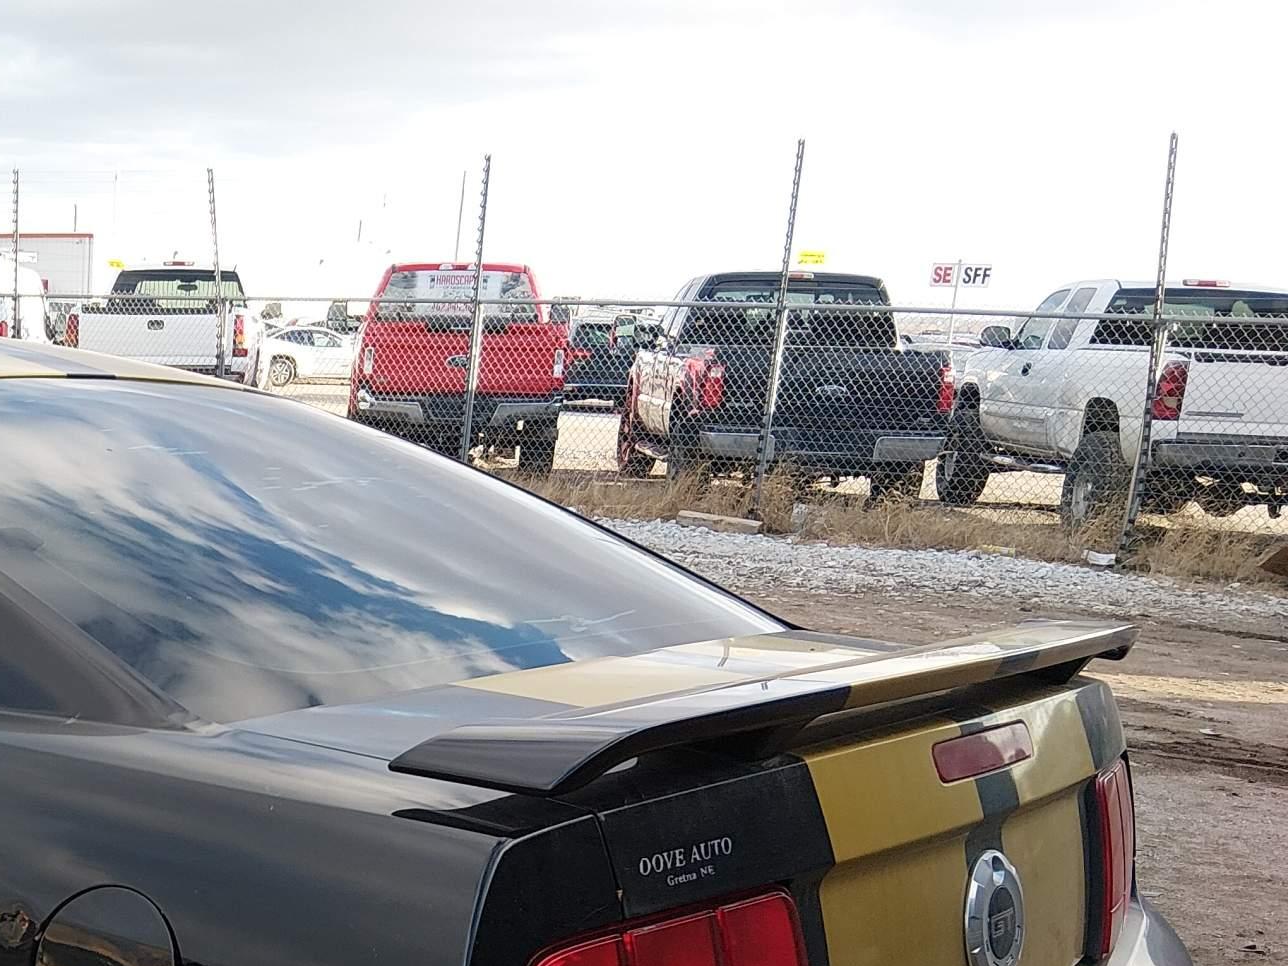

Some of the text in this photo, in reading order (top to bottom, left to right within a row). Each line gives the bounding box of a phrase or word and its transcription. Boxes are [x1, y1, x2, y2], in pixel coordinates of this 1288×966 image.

[932, 266, 953, 284] SE
[962, 266, 992, 285] SFF
[691, 837, 732, 863] AUTO
[667, 865, 716, 886] Gretna NE
